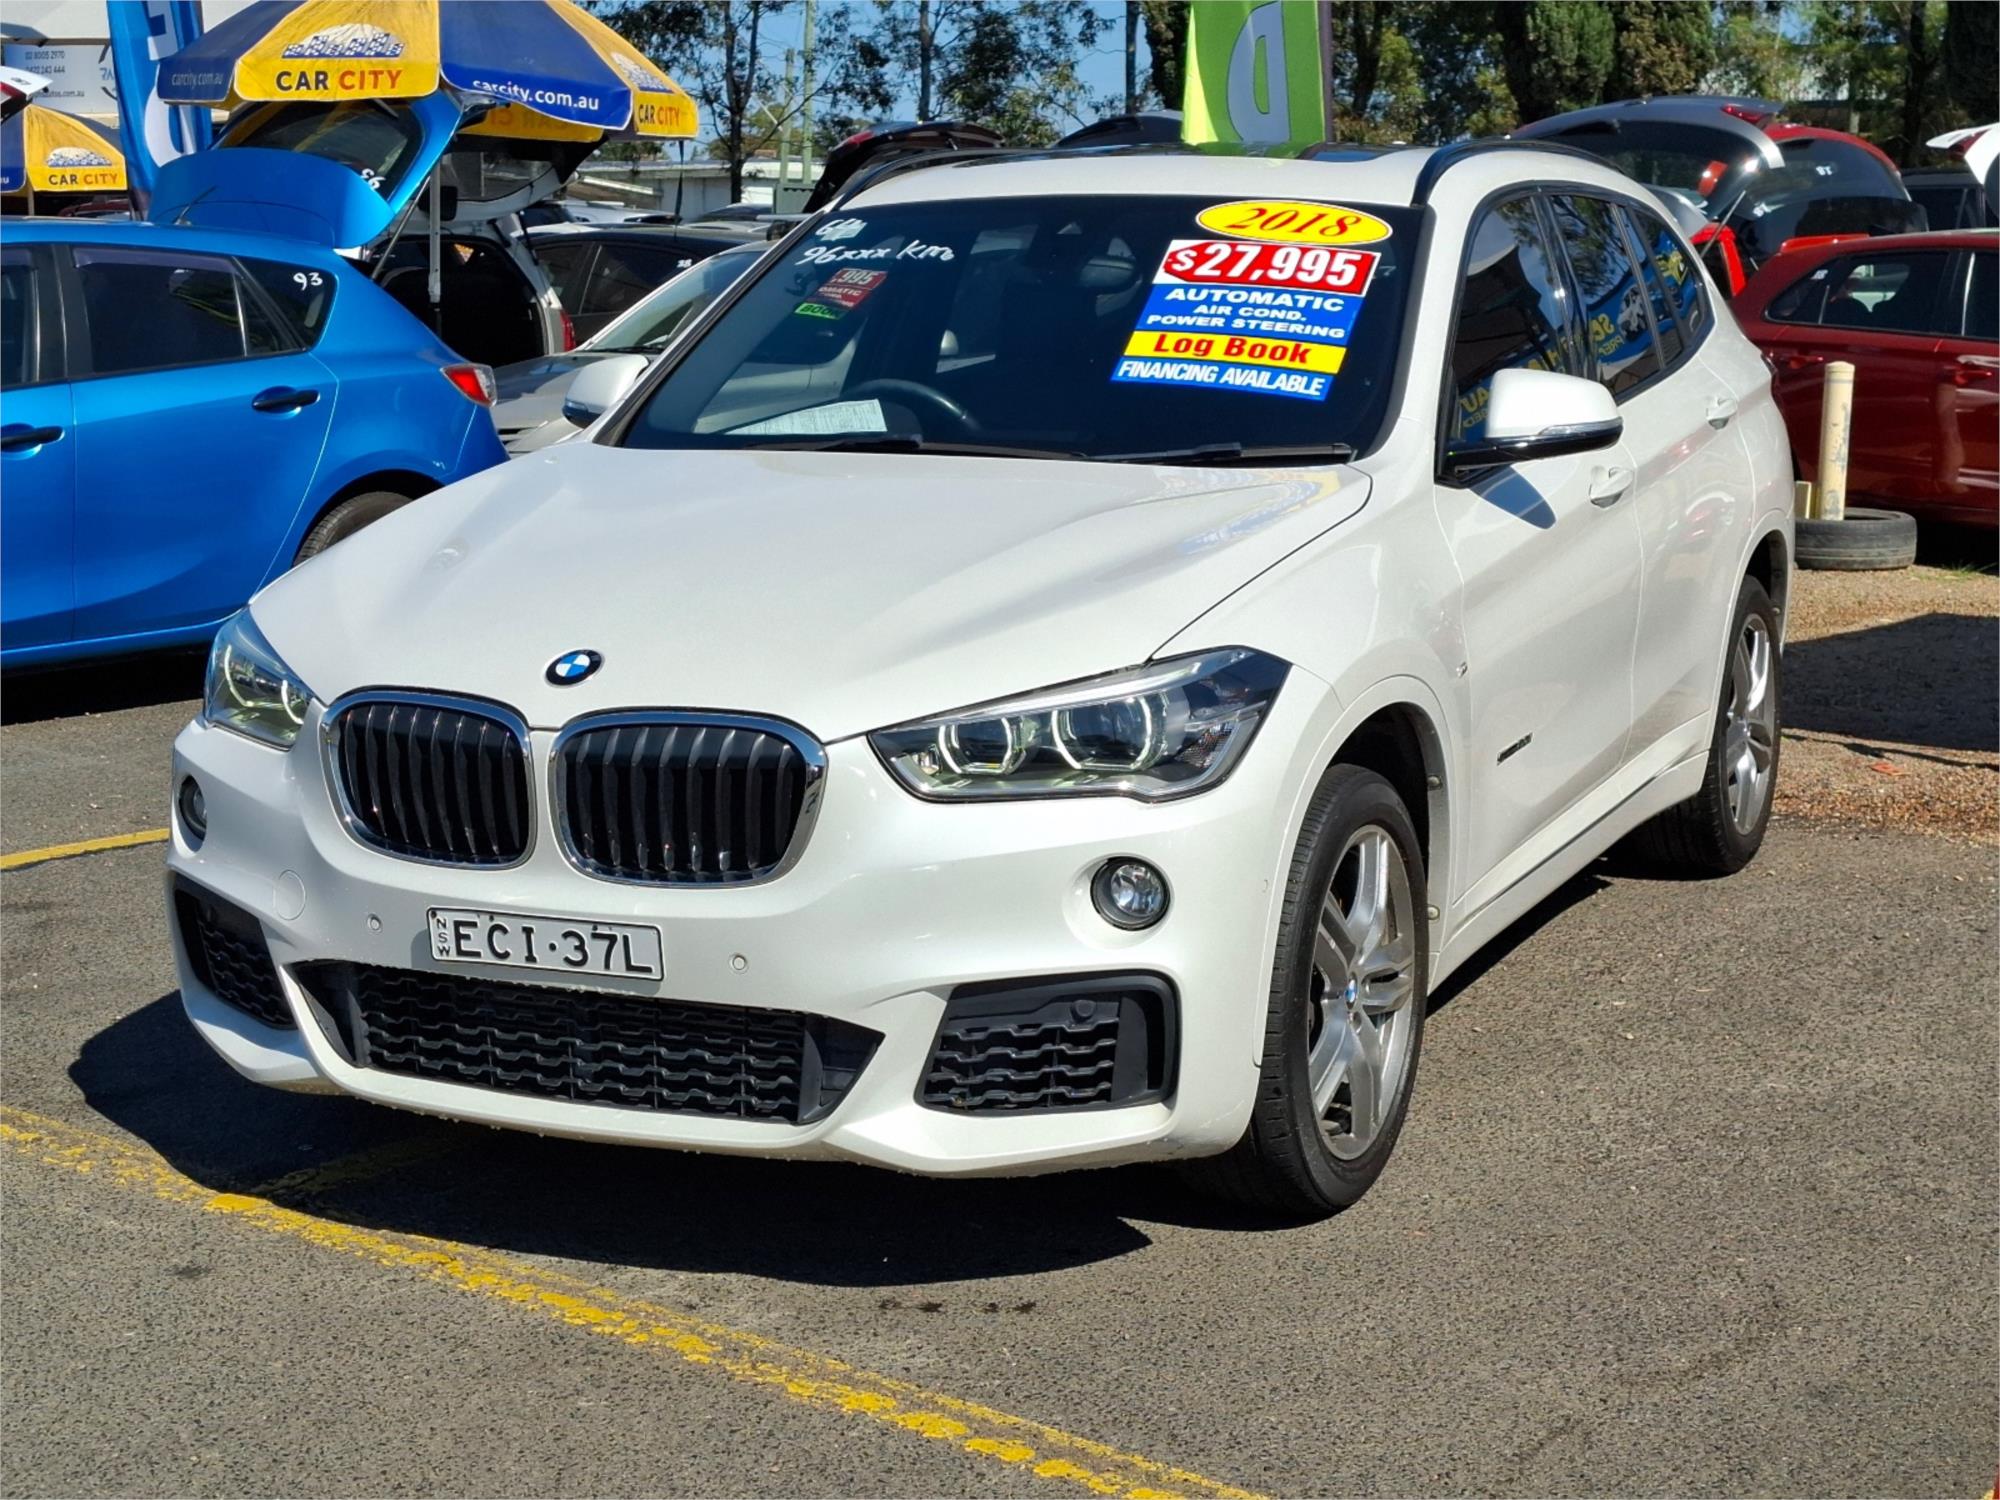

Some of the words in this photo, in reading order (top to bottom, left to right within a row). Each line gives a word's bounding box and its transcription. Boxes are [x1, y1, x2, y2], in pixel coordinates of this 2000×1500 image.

[275, 70, 329, 91] CAR
[338, 69, 403, 90] CITY
[472, 80, 599, 110] carcity.com.au
[638, 104, 656, 125] CAR
[657, 105, 680, 127] CITY
[48, 174, 79, 185] CAR
[83, 173, 118, 185] CITY
[1225, 207, 1361, 237] 2018
[1170, 243, 1362, 287] $27,995
[293, 272, 323, 290] 93
[1165, 287, 1345, 312] AUTOMATIC
[1193, 304, 1232, 316] AIR
[1238, 306, 1307, 321] COND.
[1146, 314, 1226, 328] POWER
[1231, 318, 1346, 339] STEERING
[1153, 334, 1214, 357] Log
[1223, 337, 1312, 364] Book
[1117, 360, 1220, 384] FINANCING
[1219, 366, 1326, 396] AVAILABLE
